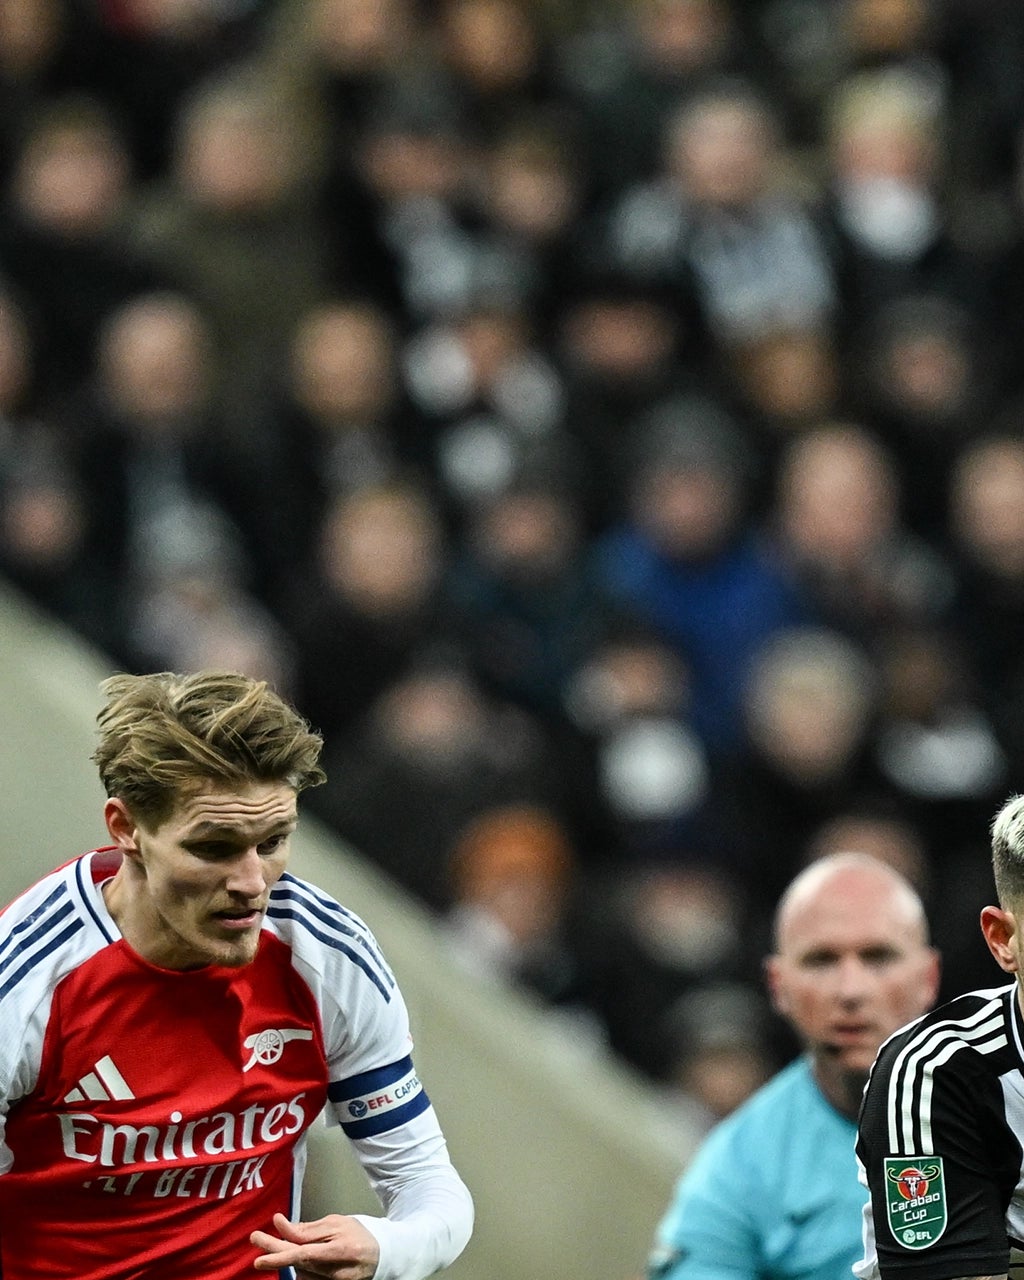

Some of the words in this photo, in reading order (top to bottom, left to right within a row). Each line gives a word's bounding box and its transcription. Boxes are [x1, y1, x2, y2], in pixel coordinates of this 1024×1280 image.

[368, 1094, 393, 1110] EFL
[56, 1092, 306, 1167] Emirates
[153, 1153, 270, 1199] BETTER
[890, 1192, 941, 1213] Carabao
[903, 1208, 927, 1222] Cup
[916, 1231, 932, 1240] EFL
